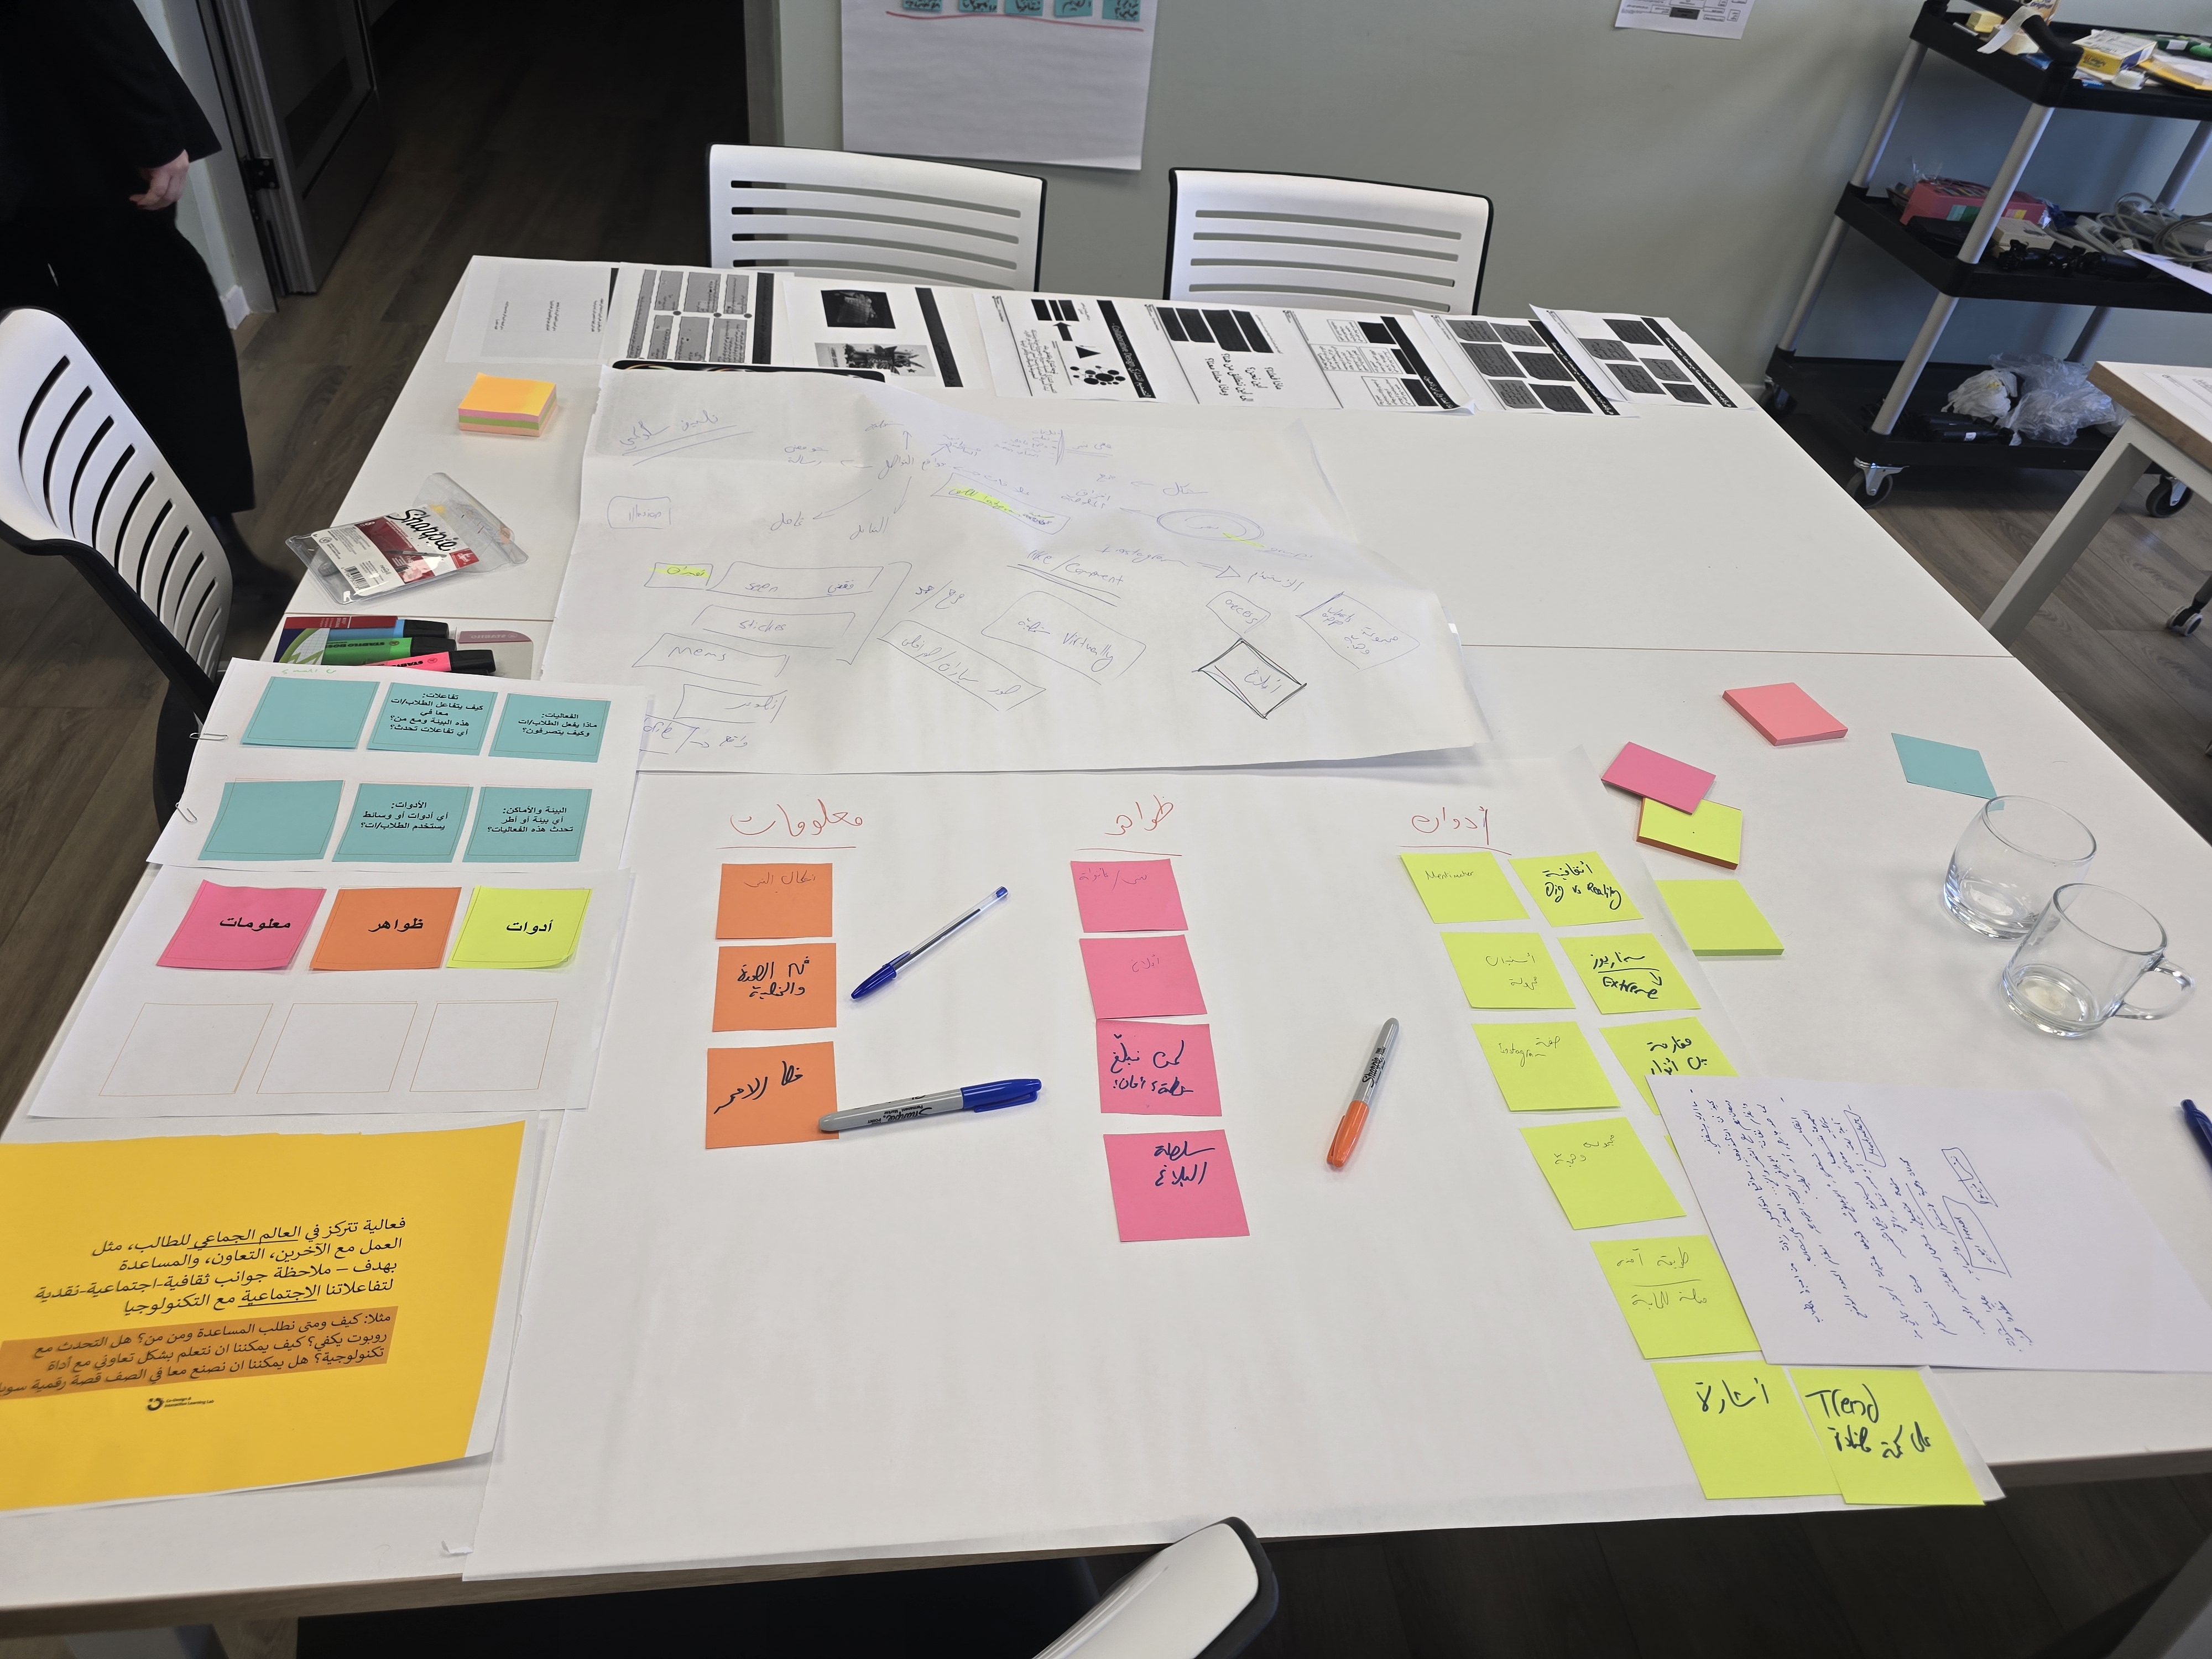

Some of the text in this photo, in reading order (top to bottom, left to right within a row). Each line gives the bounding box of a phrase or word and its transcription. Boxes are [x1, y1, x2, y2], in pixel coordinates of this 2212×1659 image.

[386, 509, 459, 551] Sharpie
[391, 698, 433, 706] الطلاب/ات
[436, 701, 462, 710] يتفاعل
[430, 717, 452, 726] البيئة
[457, 728, 468, 737] أي
[522, 727, 564, 735] يتصرفون؟
[391, 801, 427, 810] الأدوات:
[503, 807, 567, 816] البيئة والأماكن:
[363, 811, 448, 822] أي أدوات أو وسائط
[500, 816, 564, 825] أي بيئة أو أطر
[413, 823, 445, 832] يستخدم
[487, 825, 528, 833] الفعاليات؟
[219, 916, 291, 932] معلومات
[367, 917, 424, 933] ظواهر
[505, 919, 554, 935] أدوات
[92, 1217, 406, 1257] فعالية تتركز في العالم الجماعي للطالب، مثل
[119, 1237, 403, 1271] العمل مع الآخرين، التعاون، والمساعدة
[35, 1259, 397, 1299] بهدف ملاحظة جوانب ثقافية-اجتماعية-نقدية
[124, 1278, 394, 1316] لتفاعلاتنا الاجتماعية مع التكنولوجيا
[33, 1312, 391, 1359] مثلا: كيف ومتى نطلب المساعدة ومن من؟ هل التحدث مع
[46, 1332, 387, 1373] روبوت يكفي؟ كيف يمكننا ان نتعلم بشكل تعاوني مع أداة
[314, 1345, 385, 1365] تكنولوجية؟
[229, 1359, 245, 1373] ان
[248, 1355, 284, 1370] يمكننا
[288, 1354, 309, 1369] هل
[105, 1368, 148, 1383] الصف
[149, 1366, 163, 1383] في
[167, 1365, 187, 1376] معا
[190, 1361, 226, 1380] نصنع
[30, 1376, 67, 1393] رقمية
[70, 1371, 102, 1386] قصة
